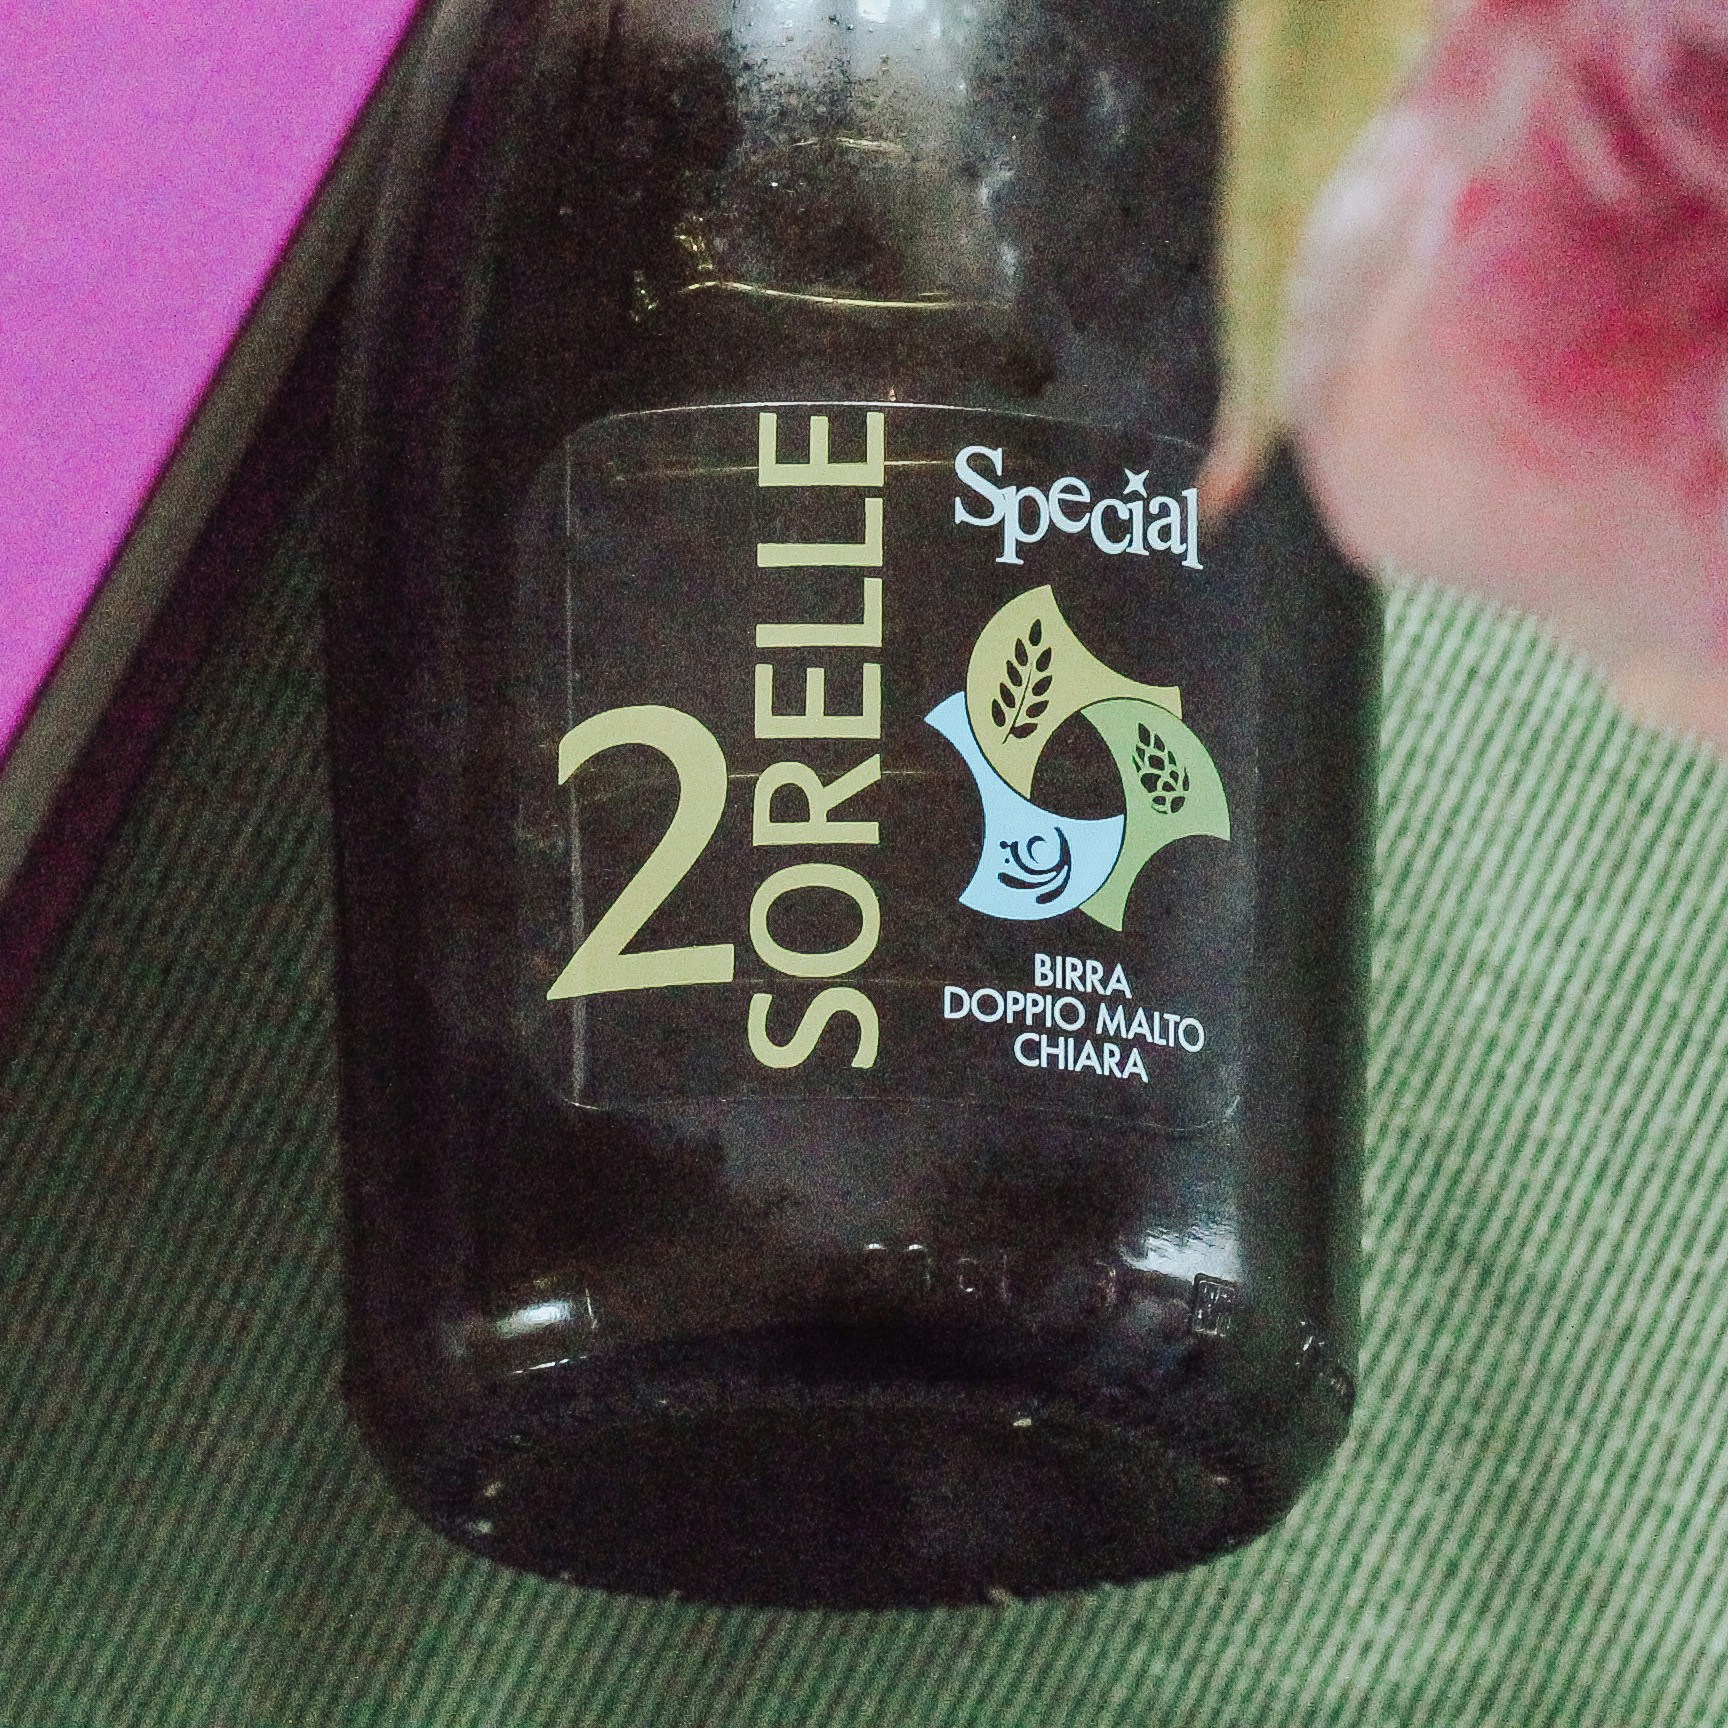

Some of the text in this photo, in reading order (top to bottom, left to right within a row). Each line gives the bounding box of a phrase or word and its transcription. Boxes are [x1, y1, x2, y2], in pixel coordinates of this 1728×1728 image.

[952, 444, 1204, 571] Special
[546, 410, 886, 1071] 2 SORELLE
[1033, 952, 1134, 1000] BIRRA
[942, 984, 1207, 1055] DOPPIO MALTO
[1012, 1031, 1151, 1085] CHIARA
